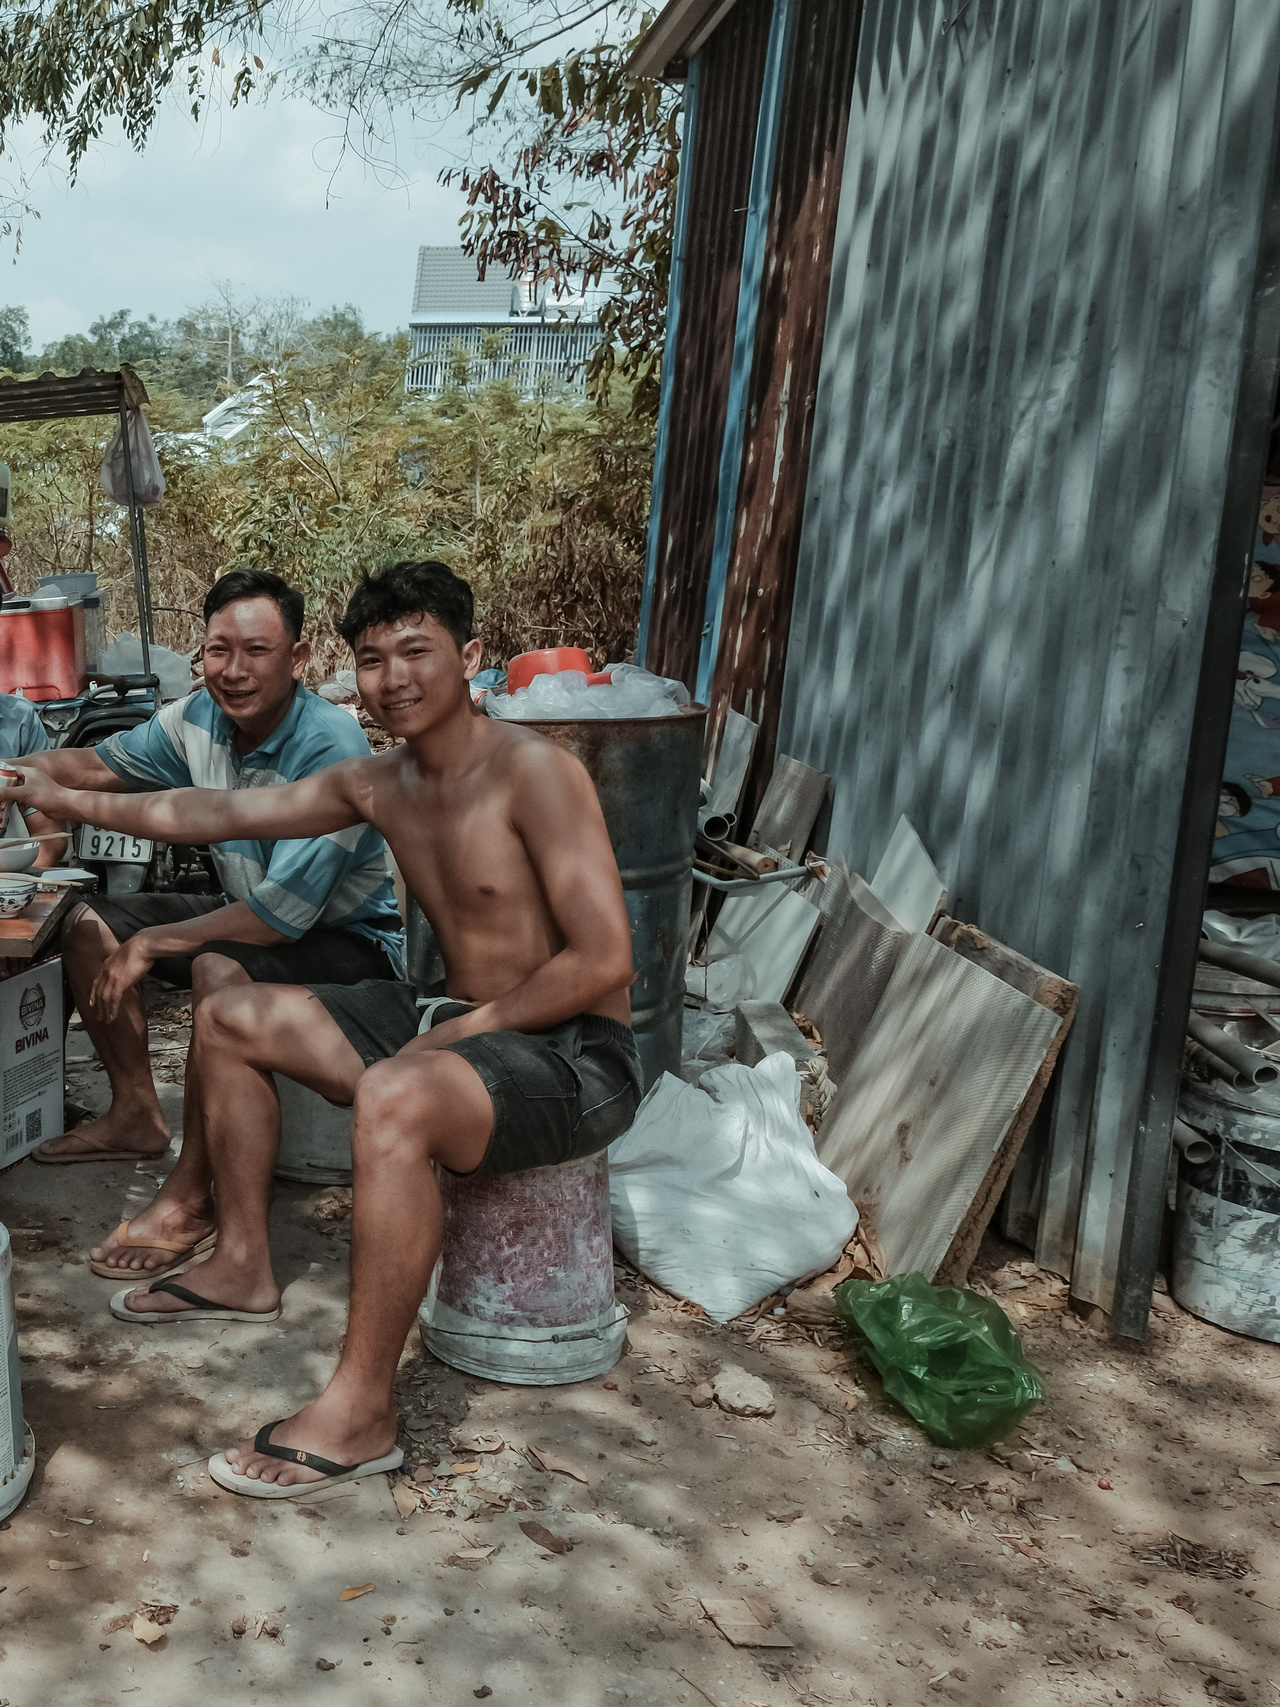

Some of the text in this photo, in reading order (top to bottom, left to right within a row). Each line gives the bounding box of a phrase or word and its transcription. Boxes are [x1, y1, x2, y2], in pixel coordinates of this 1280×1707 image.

[90, 834, 142, 858] 9215
[21, 999, 44, 1015] BIVINA
[15, 1027, 50, 1054] BIVINA
